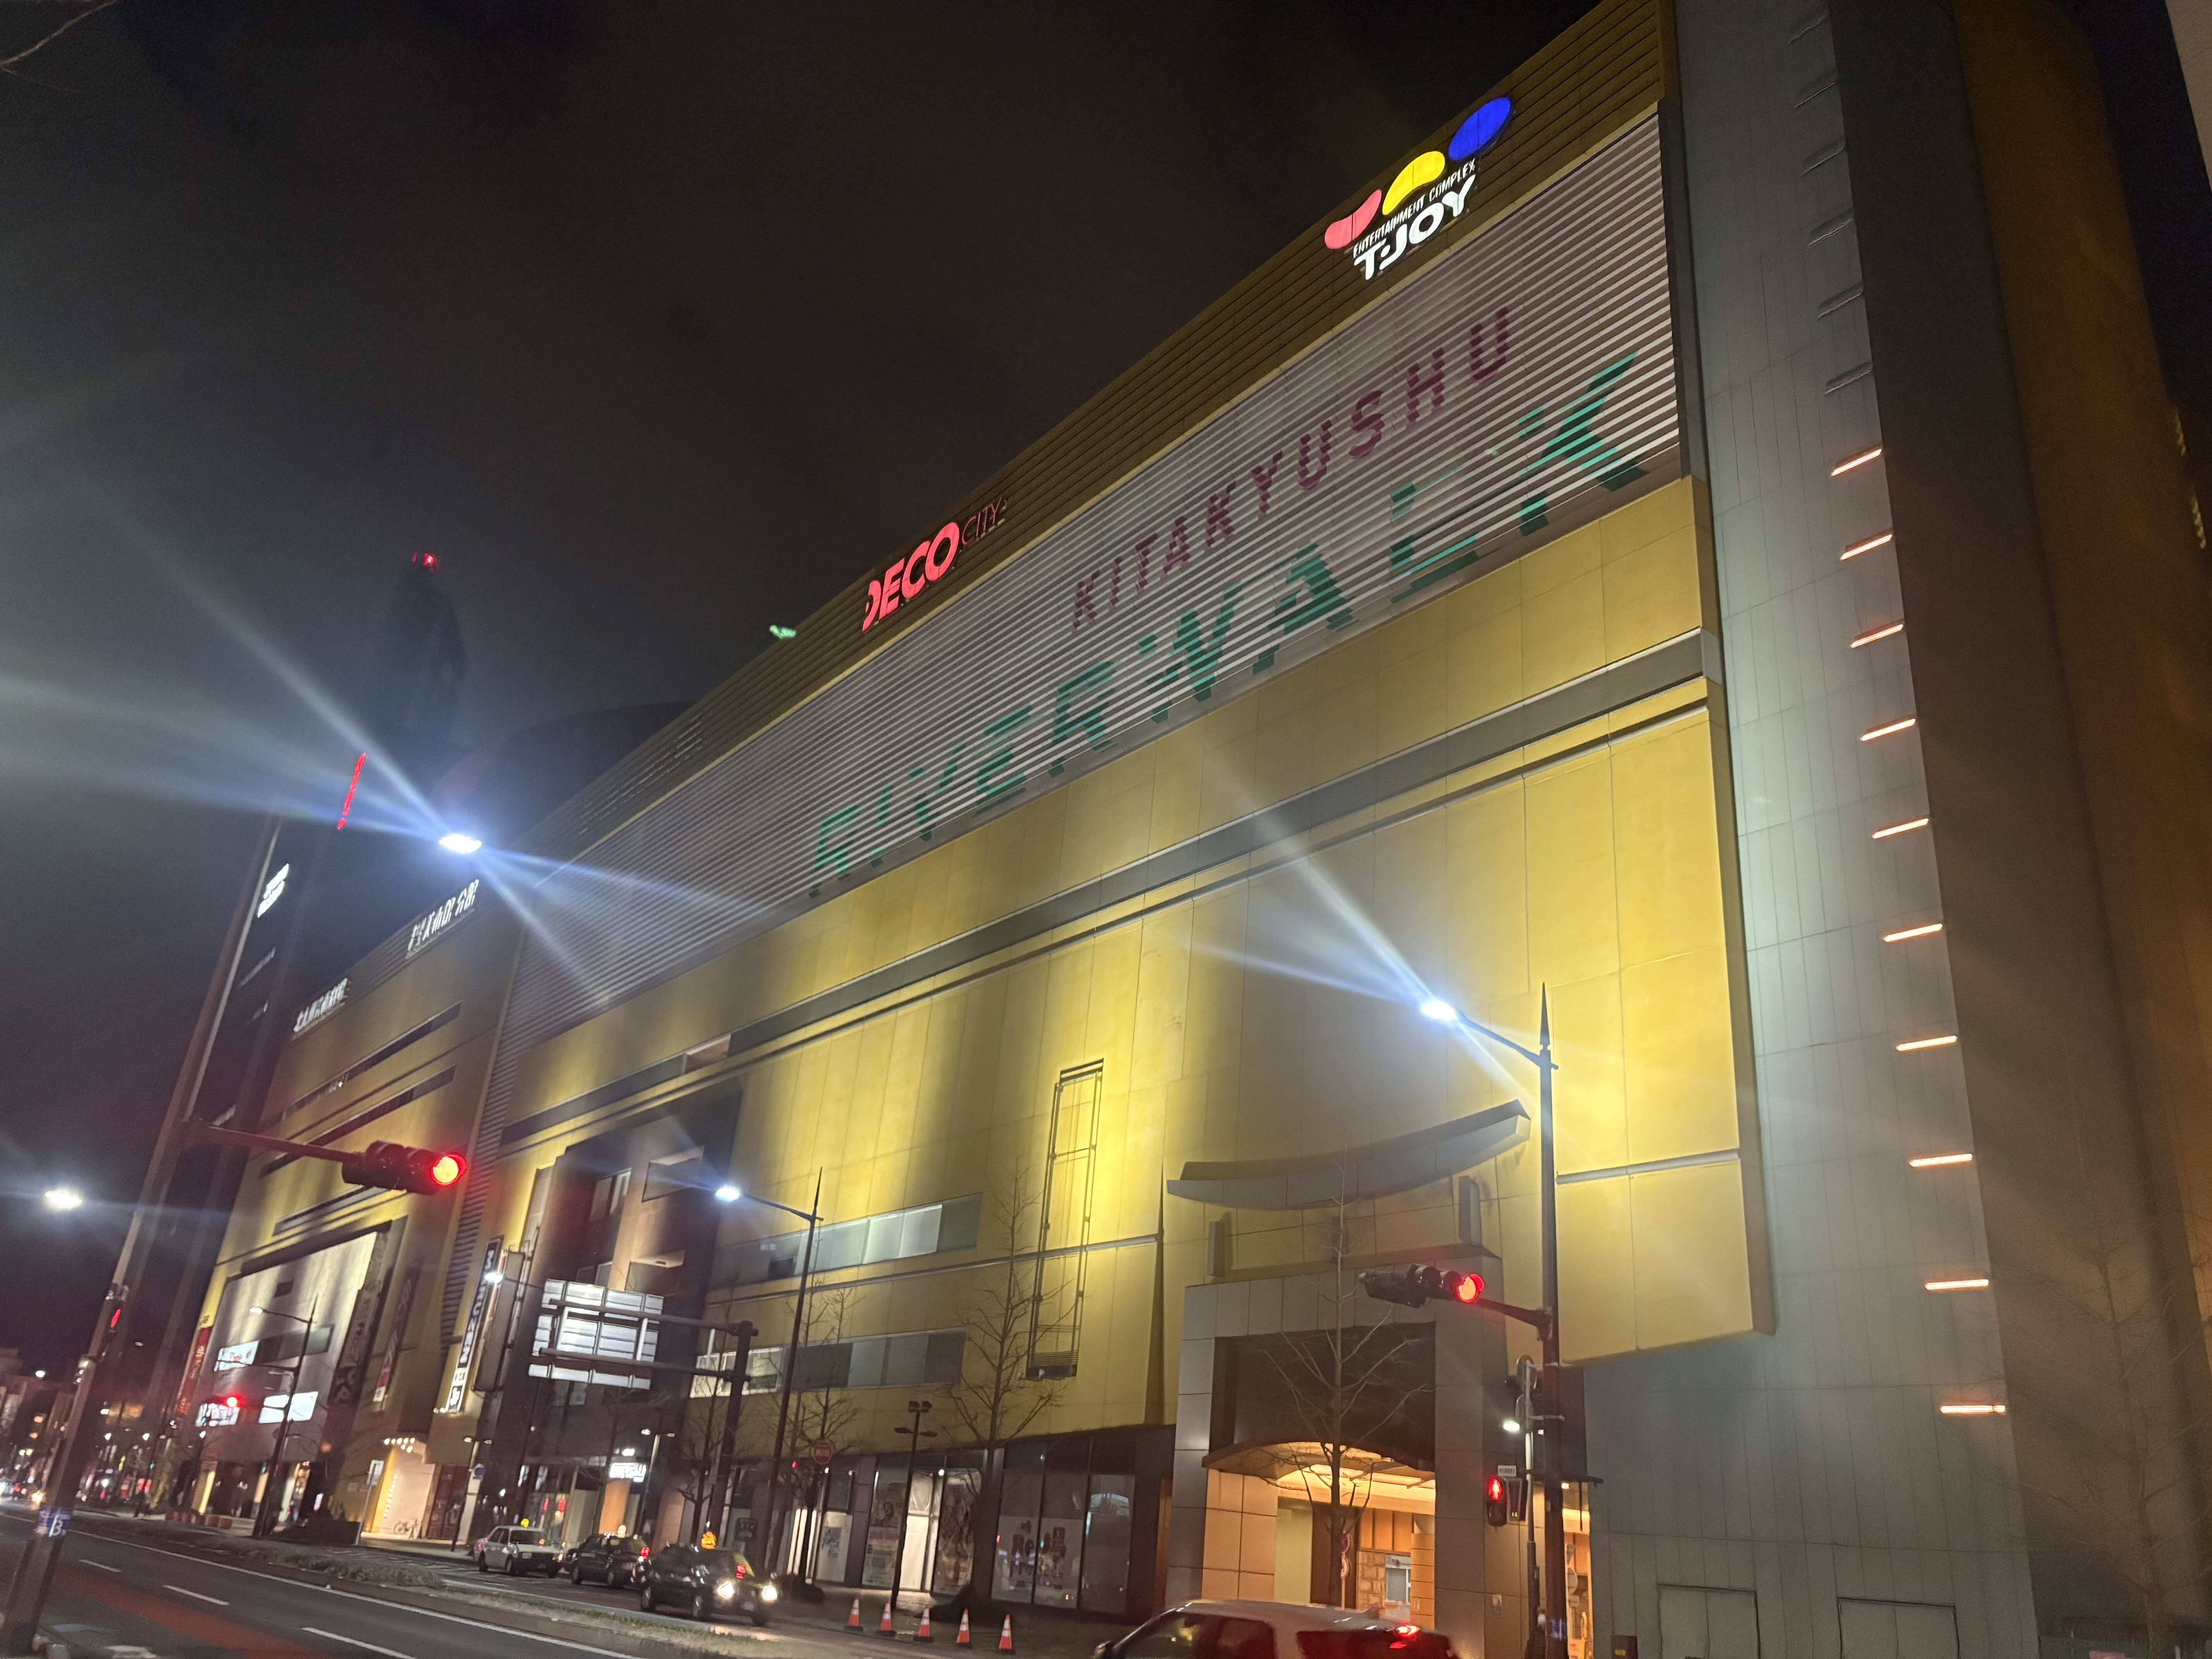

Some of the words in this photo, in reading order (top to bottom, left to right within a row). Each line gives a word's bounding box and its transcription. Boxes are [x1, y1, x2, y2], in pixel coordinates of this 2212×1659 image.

[1353, 194, 1426, 258] ENTERTAINMENT
[1429, 158, 1475, 202] COMPLEX
[1071, 307, 1510, 632] KITAKYUSHU
[962, 495, 1003, 546] CITY
